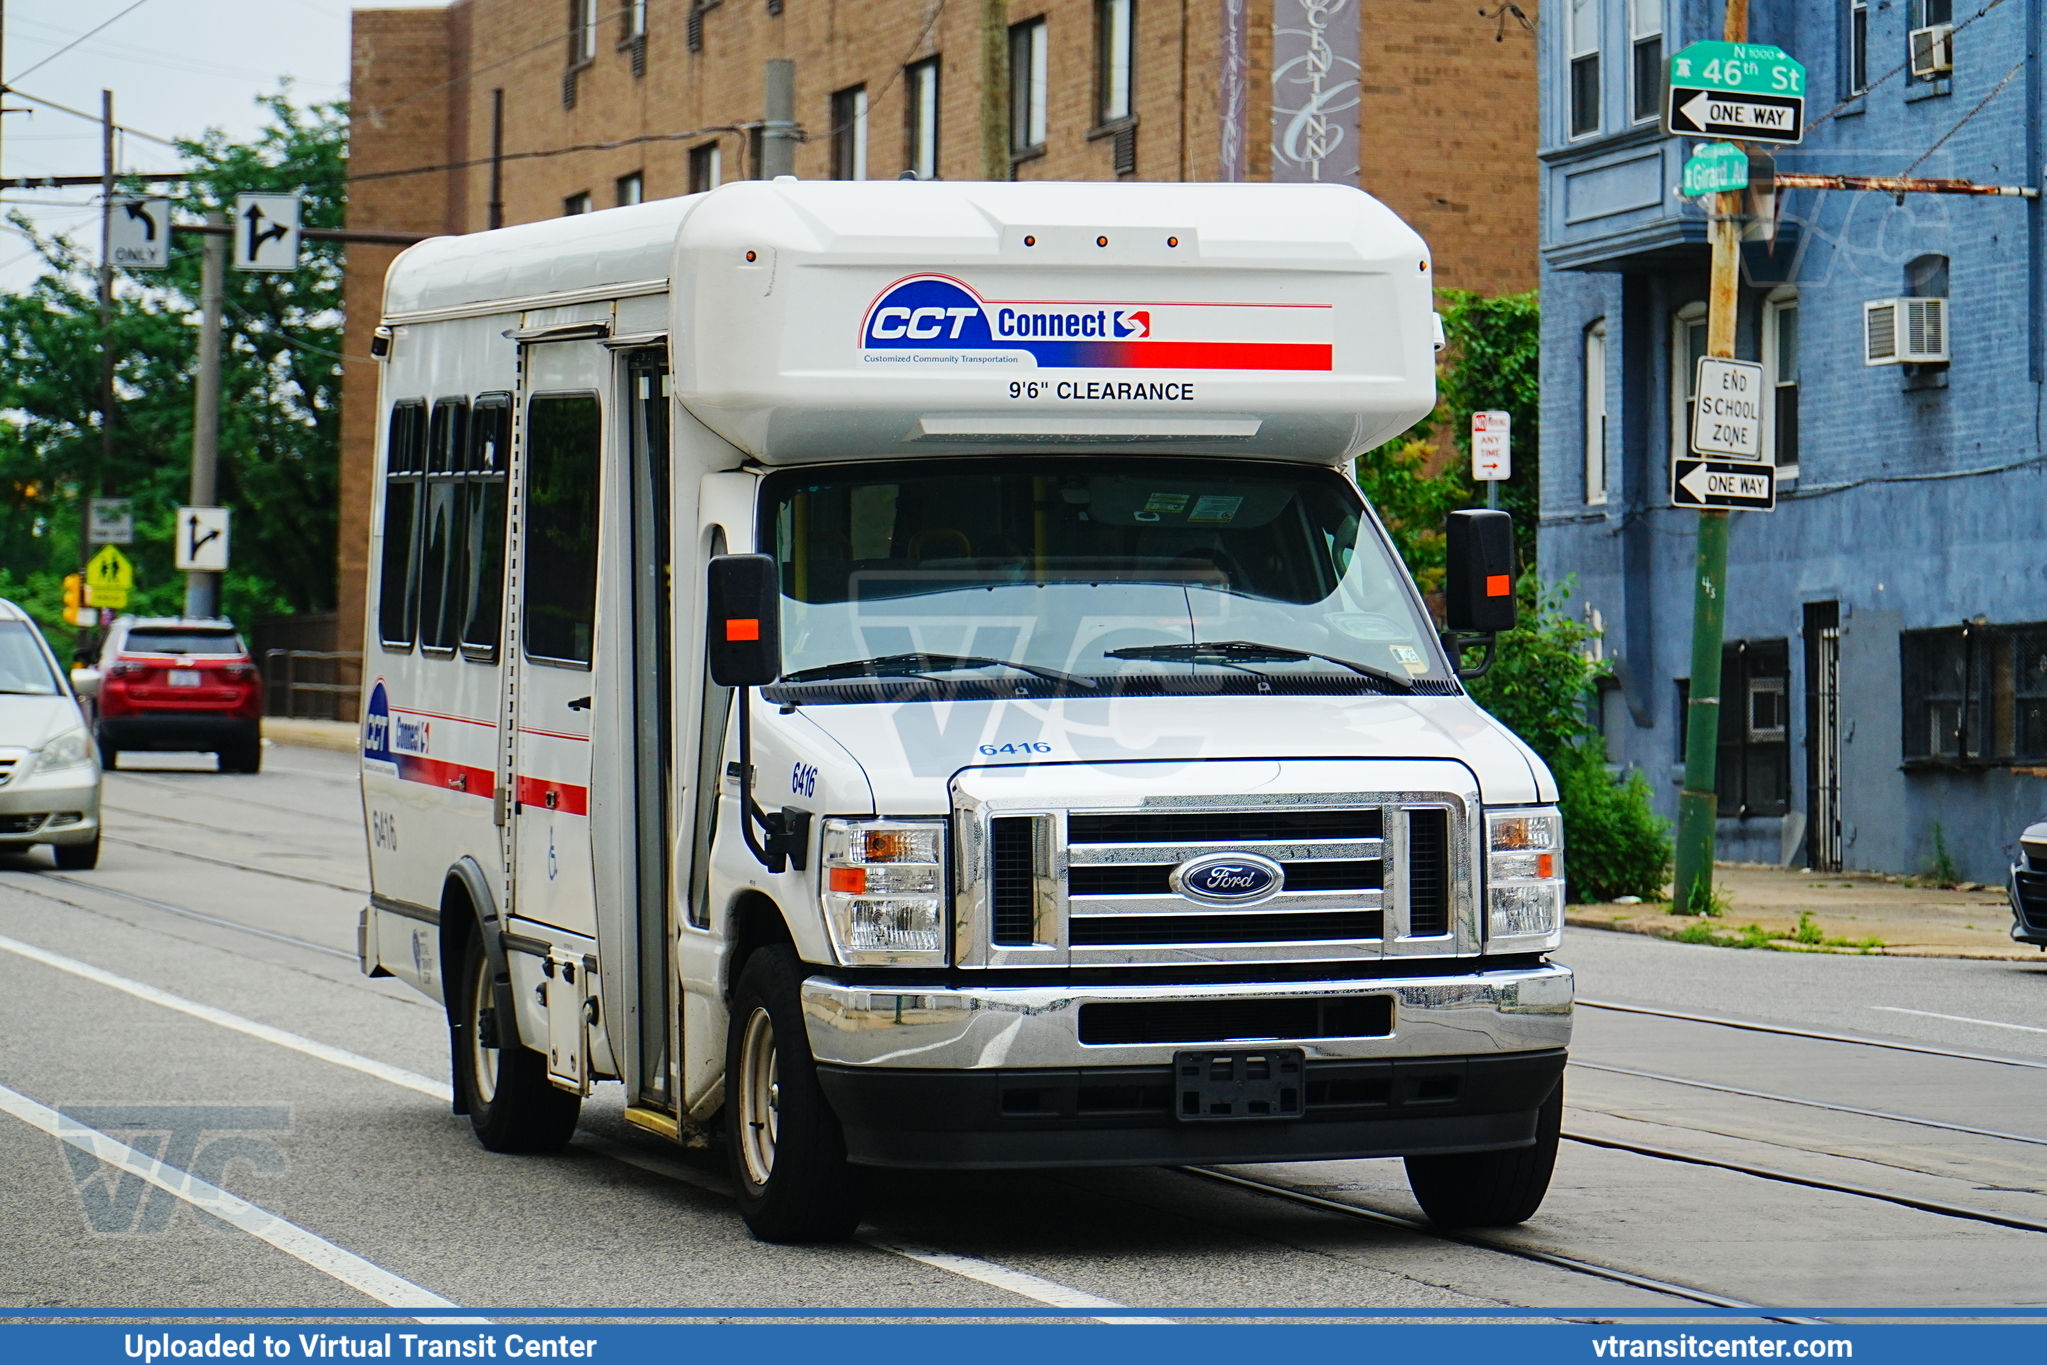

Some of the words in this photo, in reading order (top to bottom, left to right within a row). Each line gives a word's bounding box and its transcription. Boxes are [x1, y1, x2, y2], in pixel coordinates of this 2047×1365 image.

[1734, 44, 1747, 59] N
[1702, 57, 1760, 86] 46th
[1771, 65, 1801, 91] St
[1710, 103, 1745, 123] ONE
[1753, 107, 1787, 126] WAY
[1693, 159, 1728, 190] Girard
[115, 246, 159, 263] ONLY
[871, 306, 979, 340] CCT
[999, 308, 1106, 338] Connect
[864, 355, 911, 364] Customized
[913, 355, 959, 365] Community
[961, 355, 1019, 365] Transportation
[1056, 382, 1195, 401] CLEARANCE
[1723, 372, 1748, 393] END
[1702, 396, 1758, 420] SCHOOL
[1481, 436, 1500, 445] ANY
[1713, 424, 1749, 444] ZONE
[1481, 449, 1501, 458] TIME
[1708, 475, 1736, 493] ONE
[1740, 477, 1766, 495] WAY
[366, 713, 389, 752] CCT
[979, 740, 1052, 757] 6416
[792, 761, 818, 799] 6416
[373, 810, 397, 852] 6416
[1206, 866, 1256, 890] Ford
